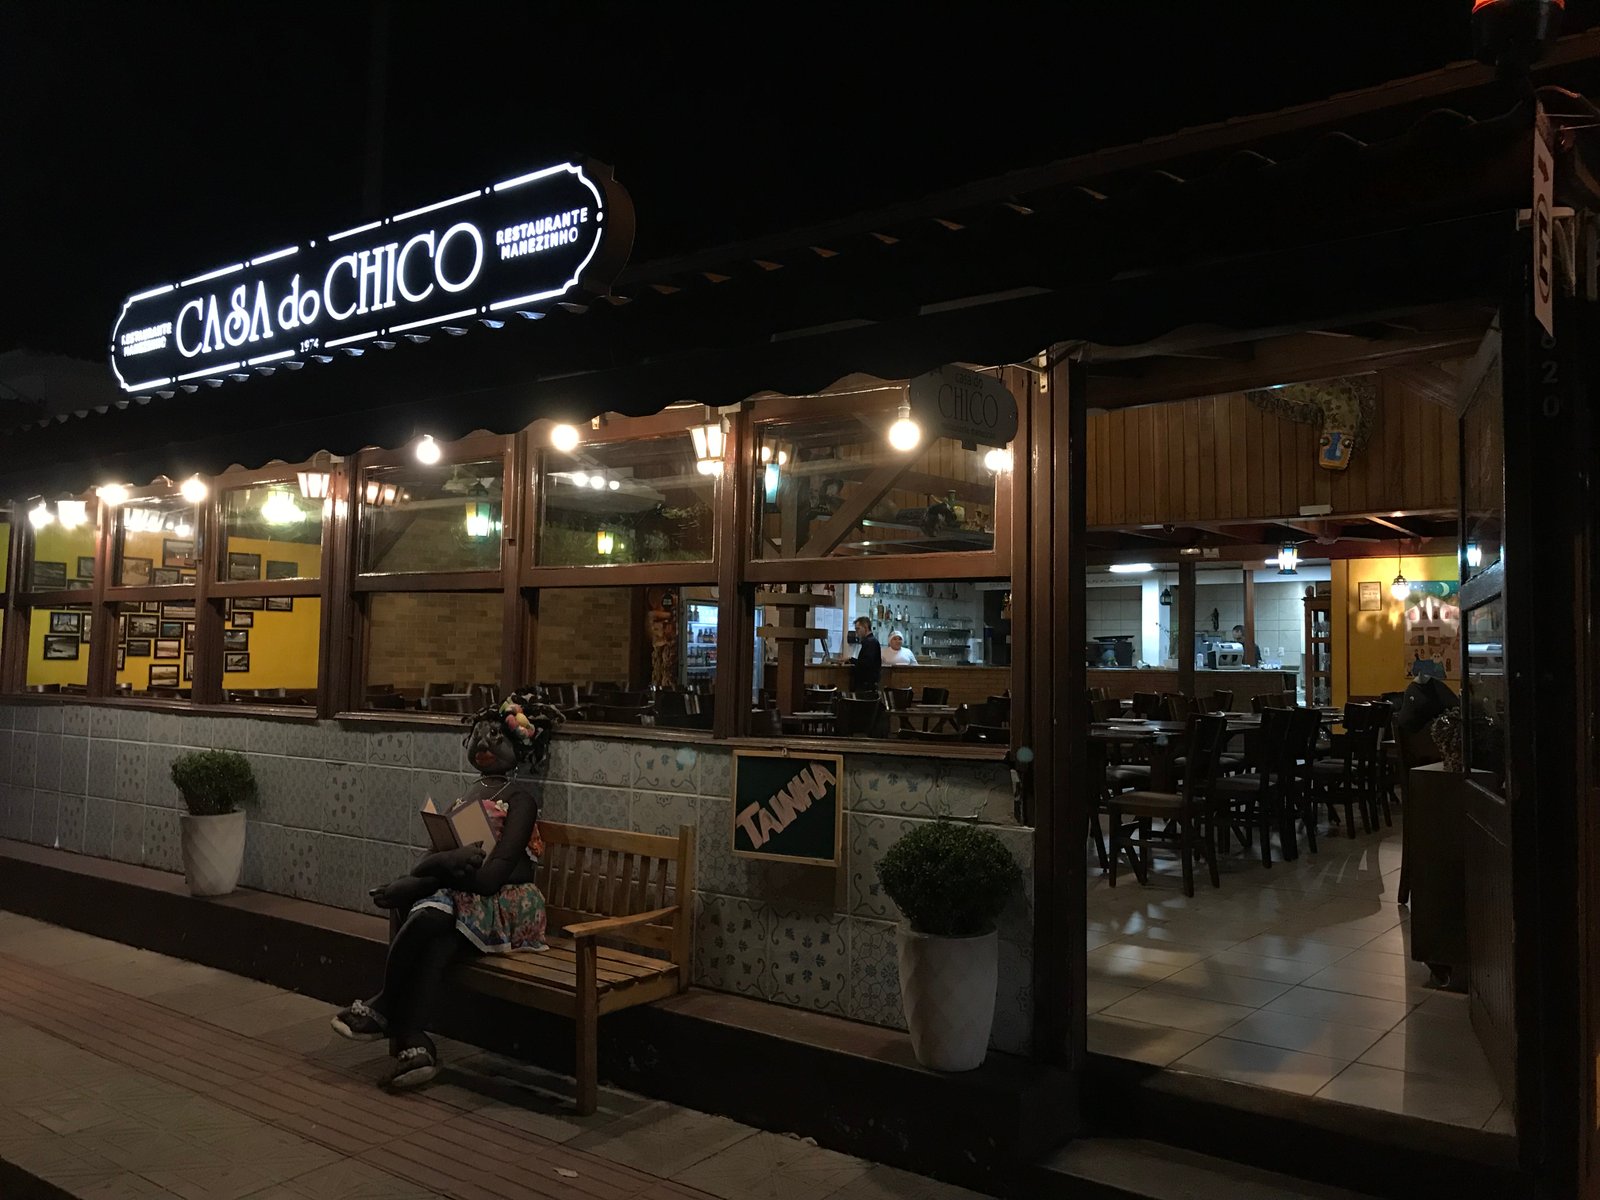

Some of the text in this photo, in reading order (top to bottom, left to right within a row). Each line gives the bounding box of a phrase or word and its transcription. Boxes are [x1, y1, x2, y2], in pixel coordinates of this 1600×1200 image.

[496, 206, 588, 246] RESTAURANTE
[501, 226, 579, 260] MANEZINHO
[175, 221, 485, 358] CASA do CHICO
[300, 337, 319, 353] 1974
[938, 383, 999, 428] CHICO
[735, 760, 837, 850] TAINHA
